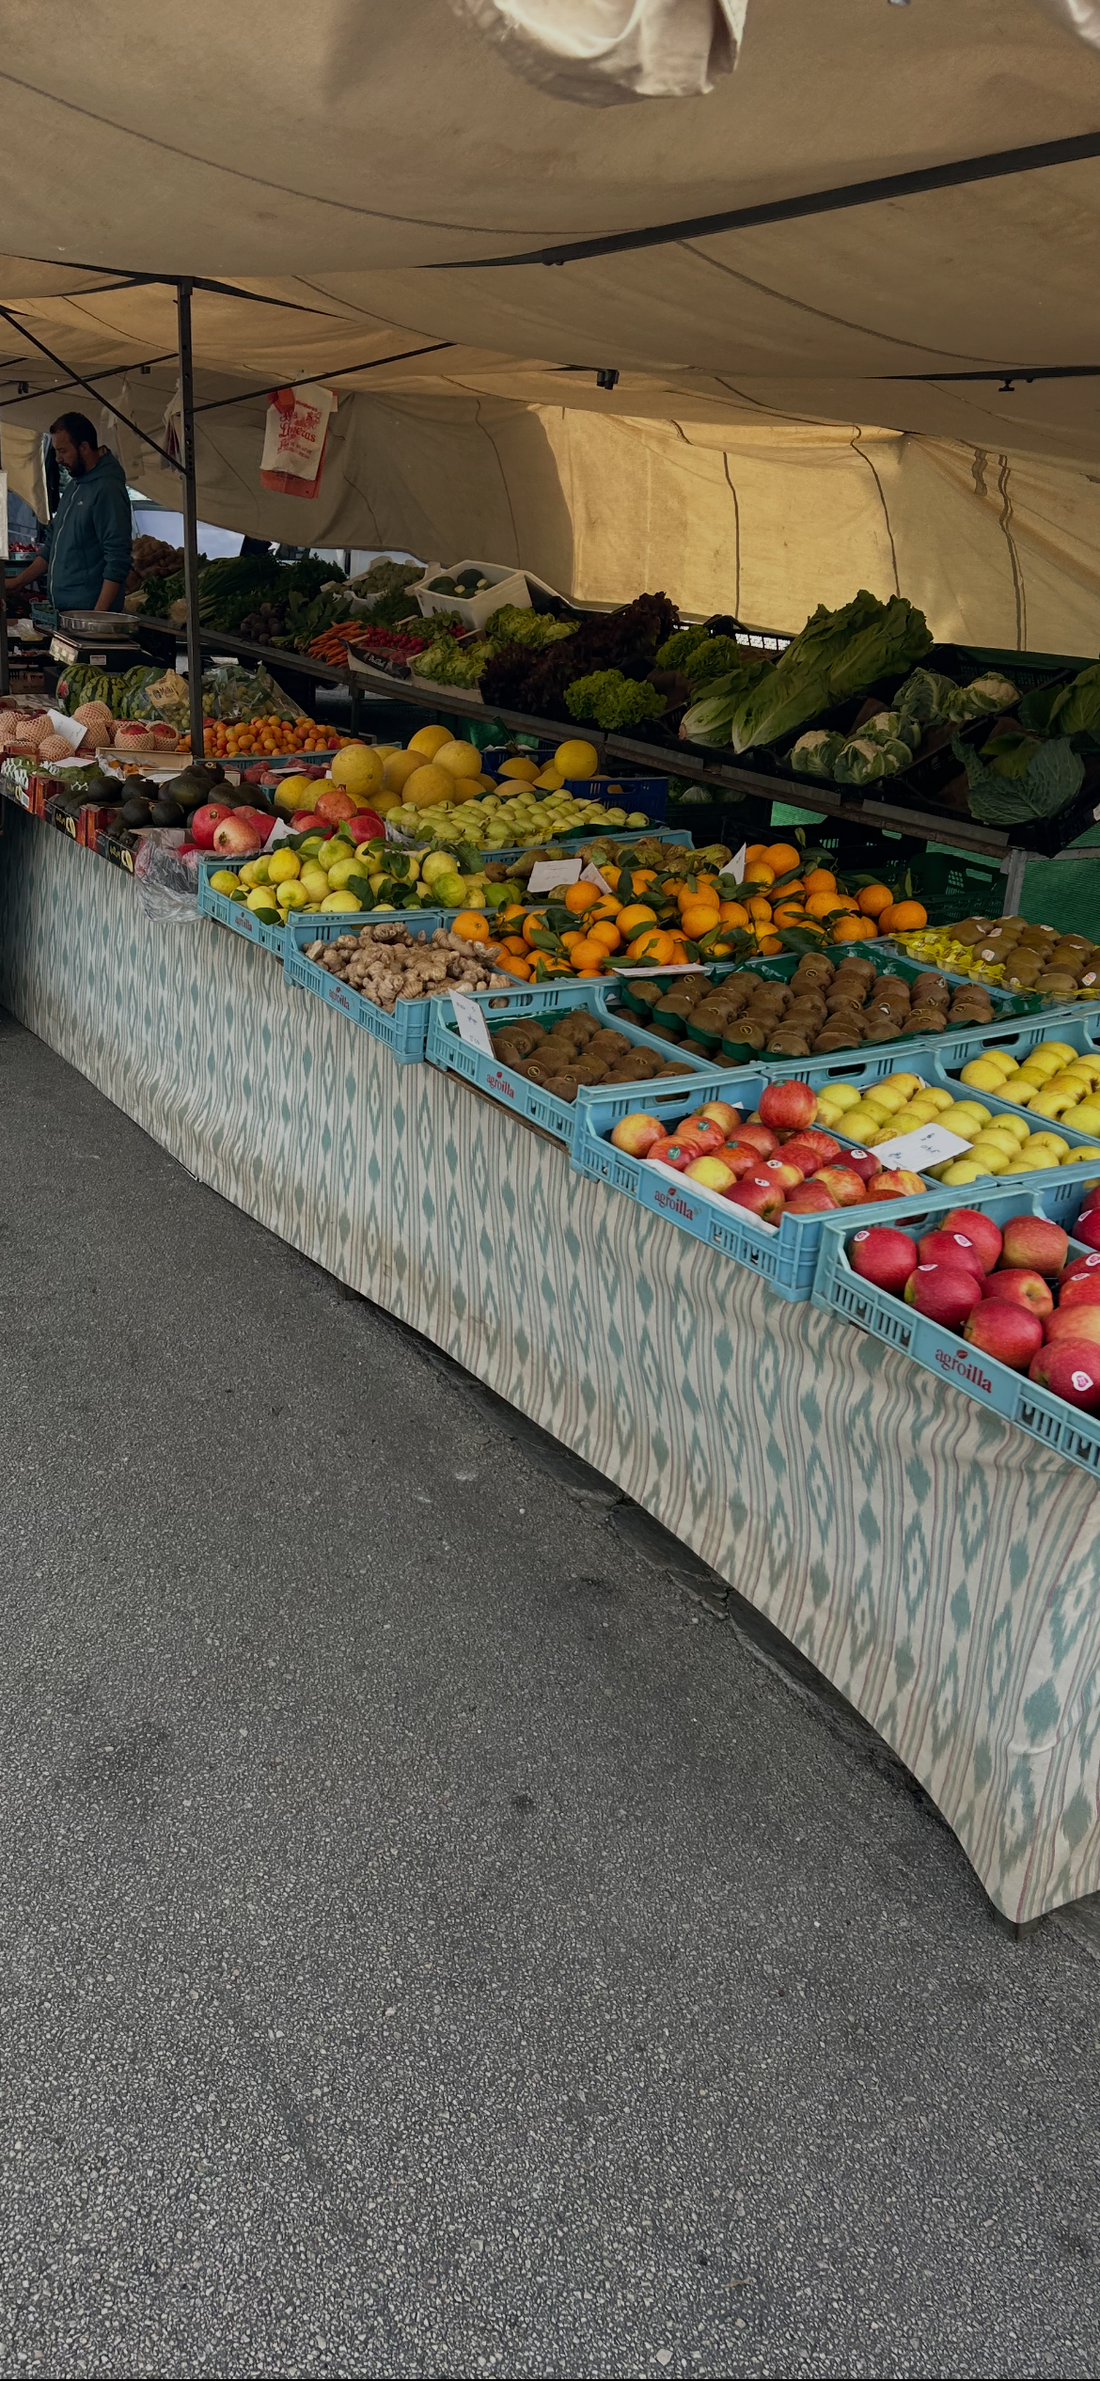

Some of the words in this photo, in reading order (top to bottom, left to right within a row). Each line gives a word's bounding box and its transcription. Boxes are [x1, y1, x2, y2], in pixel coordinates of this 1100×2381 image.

[328, 989, 350, 1010] agroilla
[486, 1073, 514, 1098] agroilla
[654, 1190, 693, 1220] agroilla
[935, 1348, 992, 1394] agroilla
